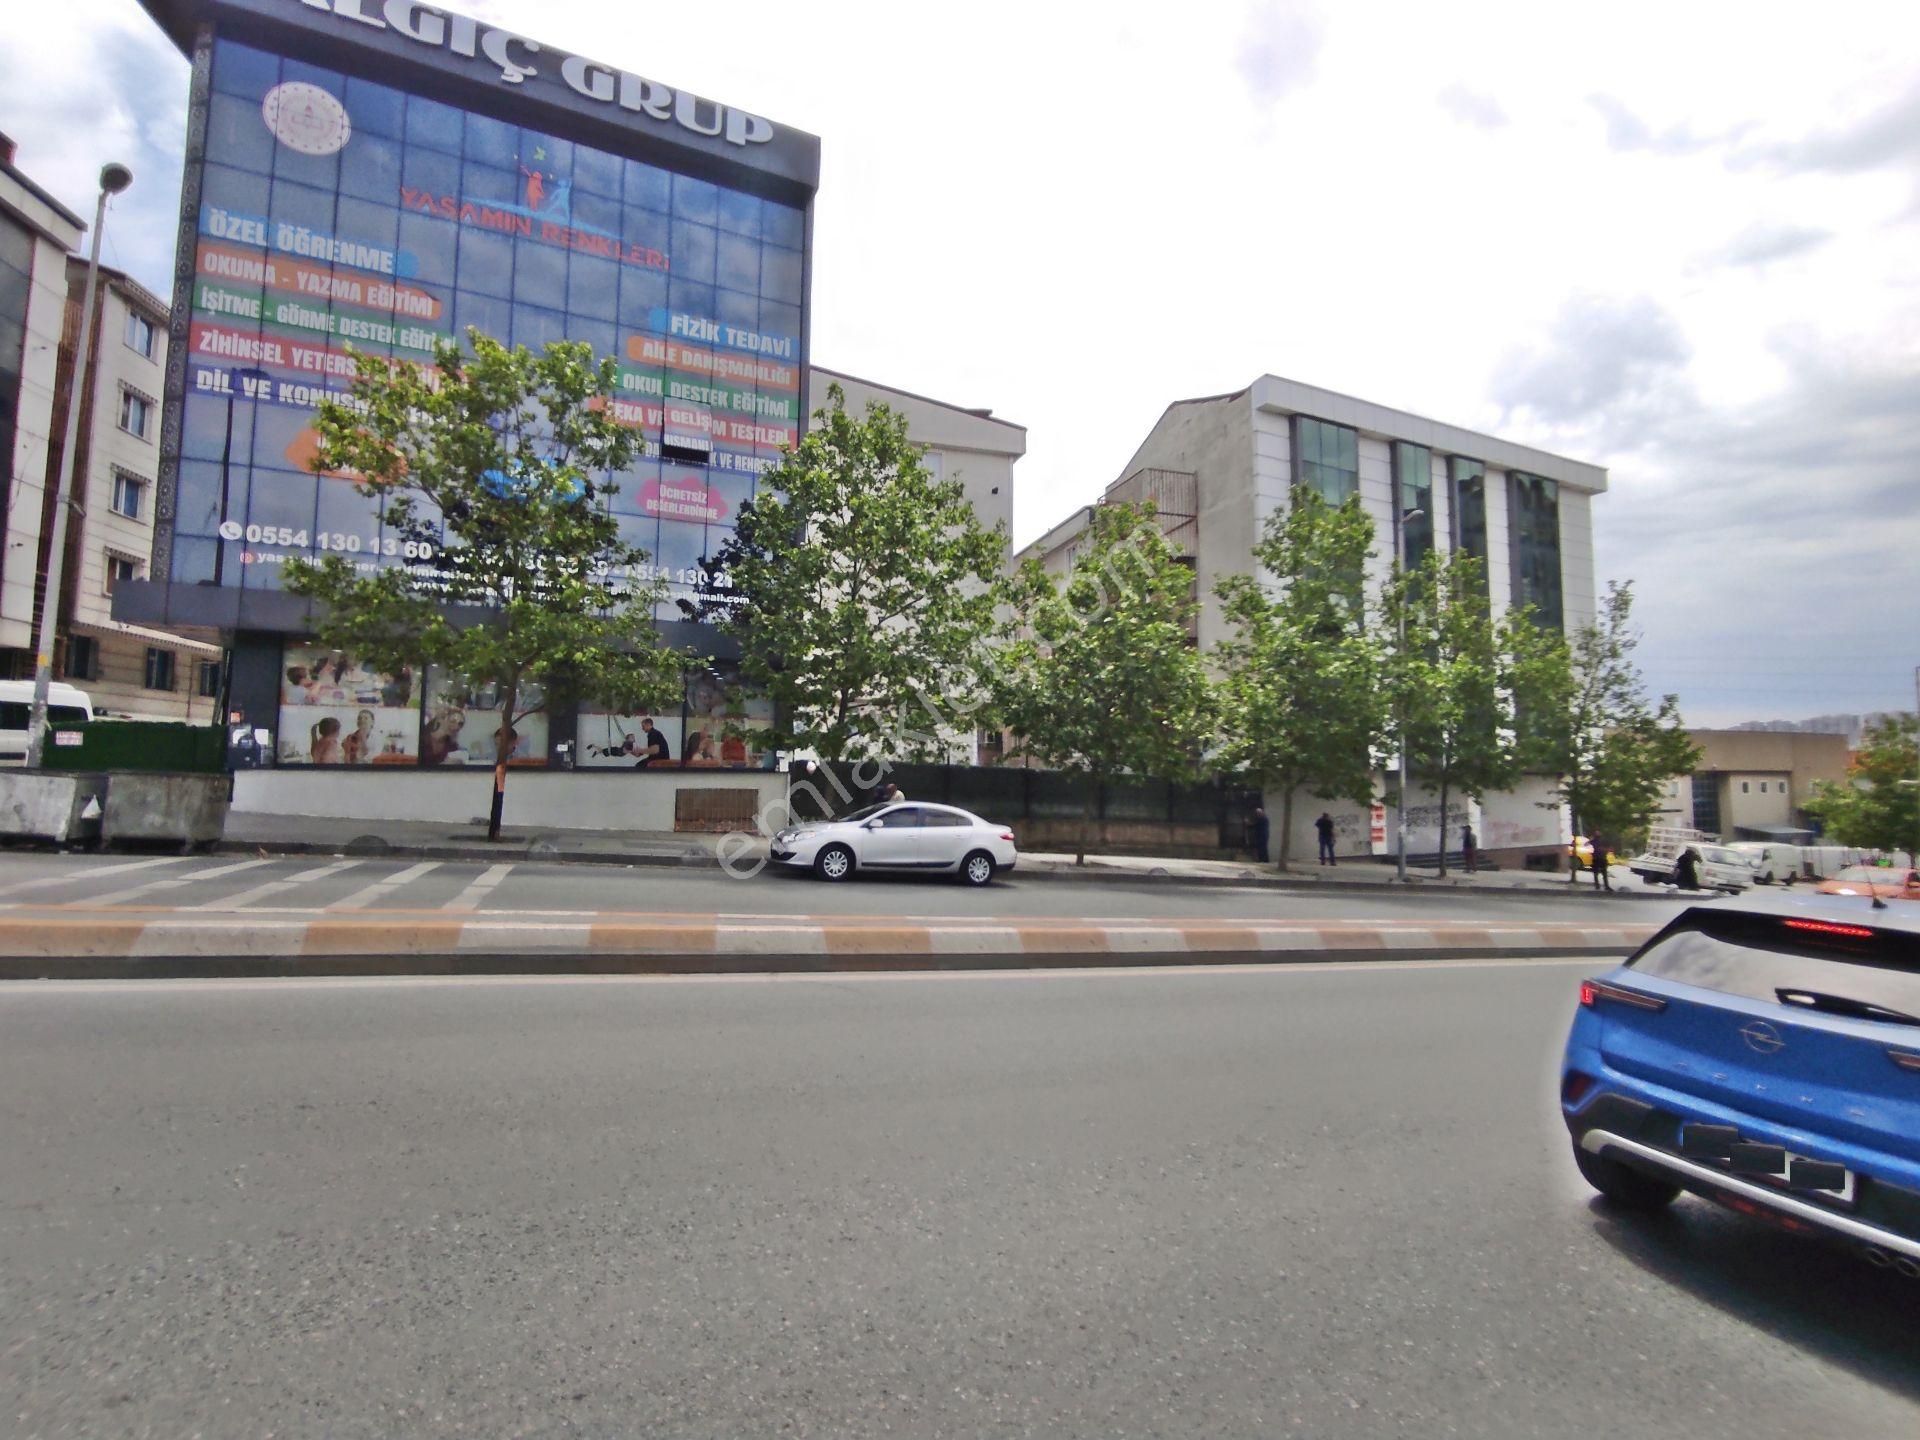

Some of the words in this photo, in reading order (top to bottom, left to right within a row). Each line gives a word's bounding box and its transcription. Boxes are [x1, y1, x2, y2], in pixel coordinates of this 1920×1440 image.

[297, 0, 540, 83] LGIÇ
[561, 55, 774, 146] GRUP
[209, 208, 268, 246] ÖZEL
[277, 222, 393, 275] ÖĞRENME
[204, 251, 275, 284] OKUMA
[297, 270, 361, 302] YAZMA
[202, 286, 260, 319] İŞİTME
[277, 302, 335, 333] GÖRME
[340, 316, 397, 345] DESTEK
[671, 314, 720, 343] FİZİK
[727, 327, 791, 357] TEDAVİ
[200, 329, 284, 364] ZİHİNSEL
[643, 341, 676, 361] AİLE
[197, 369, 234, 394] DİL
[243, 375, 271, 400] VE
[623, 374, 663, 396] OKUL
[671, 382, 729, 407] DESTEK
[246, 525, 308, 548] 0554
[317, 532, 361, 552] 130
[370, 537, 398, 555] 13
[404, 541, 433, 560] 60
[676, 568, 708, 586] 130
